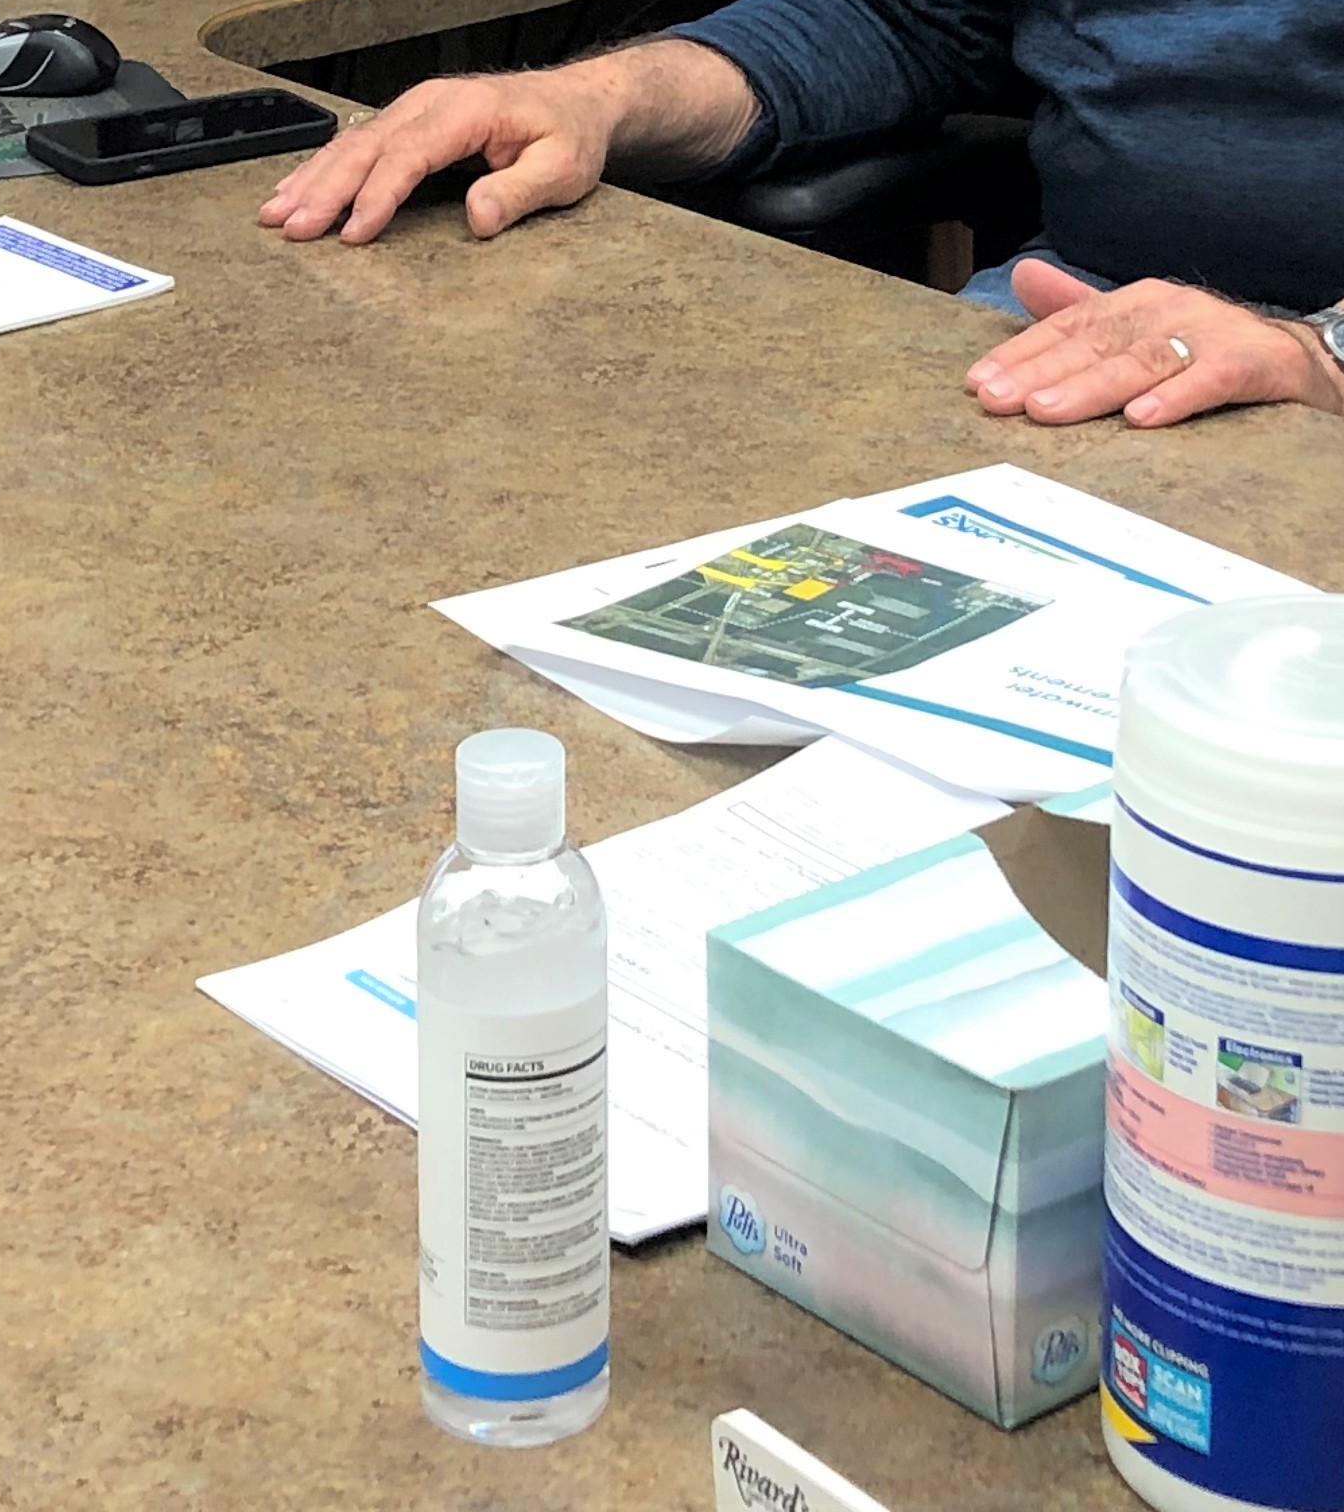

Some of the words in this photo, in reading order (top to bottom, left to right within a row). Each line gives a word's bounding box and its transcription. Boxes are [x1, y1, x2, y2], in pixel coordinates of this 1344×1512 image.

[469, 1059, 504, 1073] DRUG
[506, 1061, 545, 1073] FACTS
[726, 1194, 759, 1242] Puffs
[774, 1225, 808, 1257] Ultra
[774, 1244, 803, 1277] Soft
[1152, 1338, 1210, 1379] CLIPPING
[1153, 1364, 1203, 1402] SCAN
